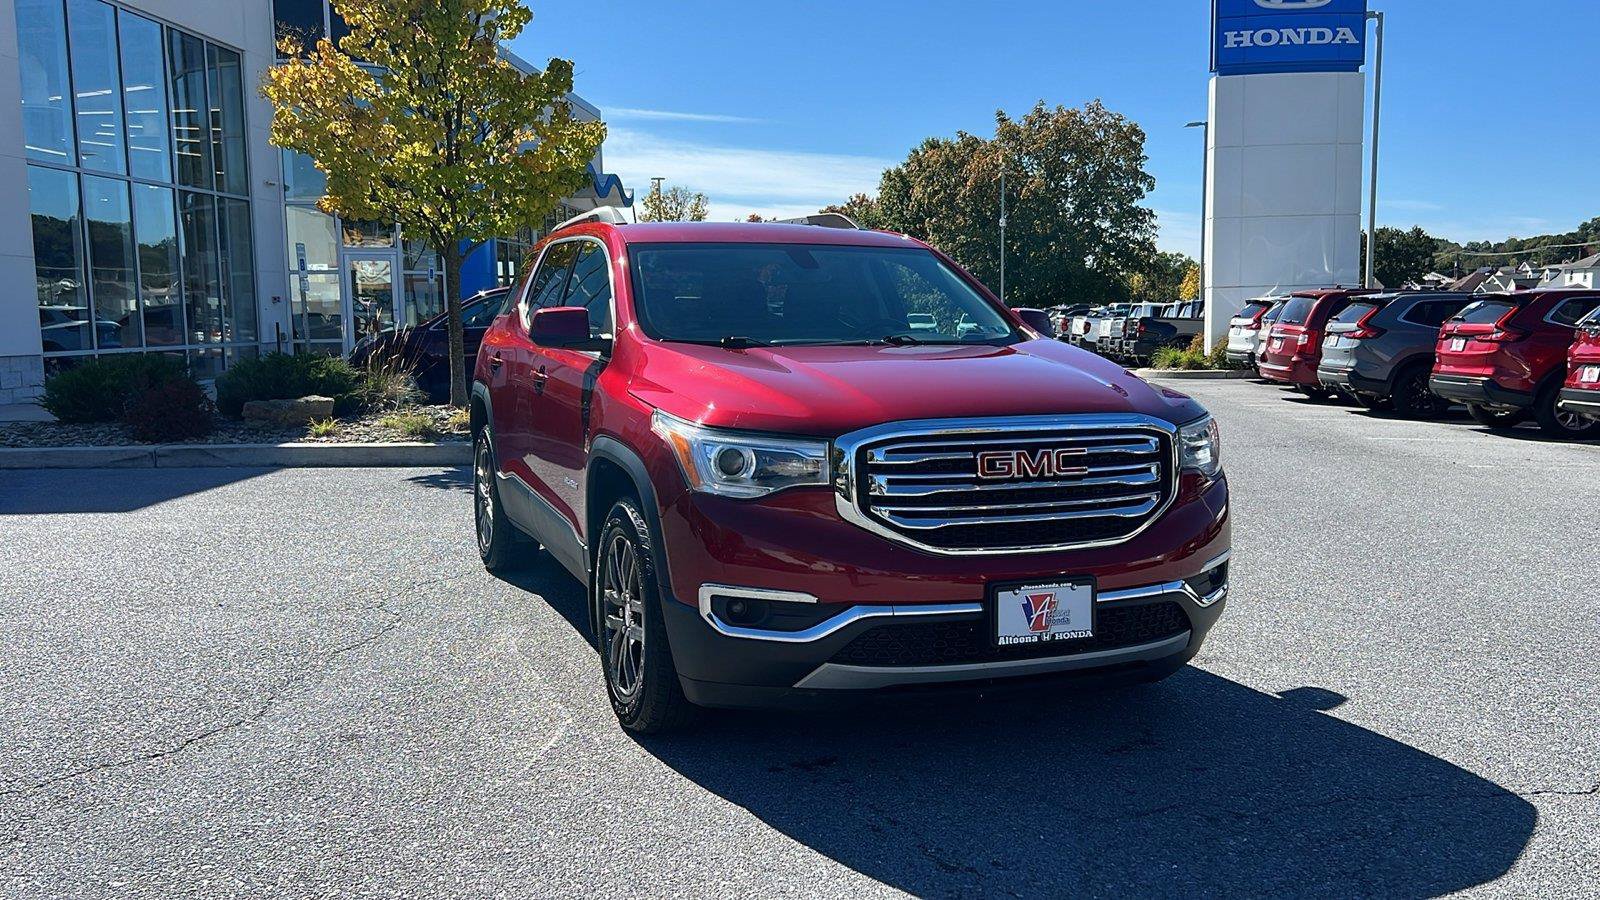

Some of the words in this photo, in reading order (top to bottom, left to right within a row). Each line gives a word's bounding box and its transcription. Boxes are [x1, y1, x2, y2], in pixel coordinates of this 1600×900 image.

[1224, 27, 1360, 48] HONDA
[977, 447, 1088, 478] GMC
[998, 635, 1038, 645] Altoona
[1055, 630, 1093, 640] HONDA
